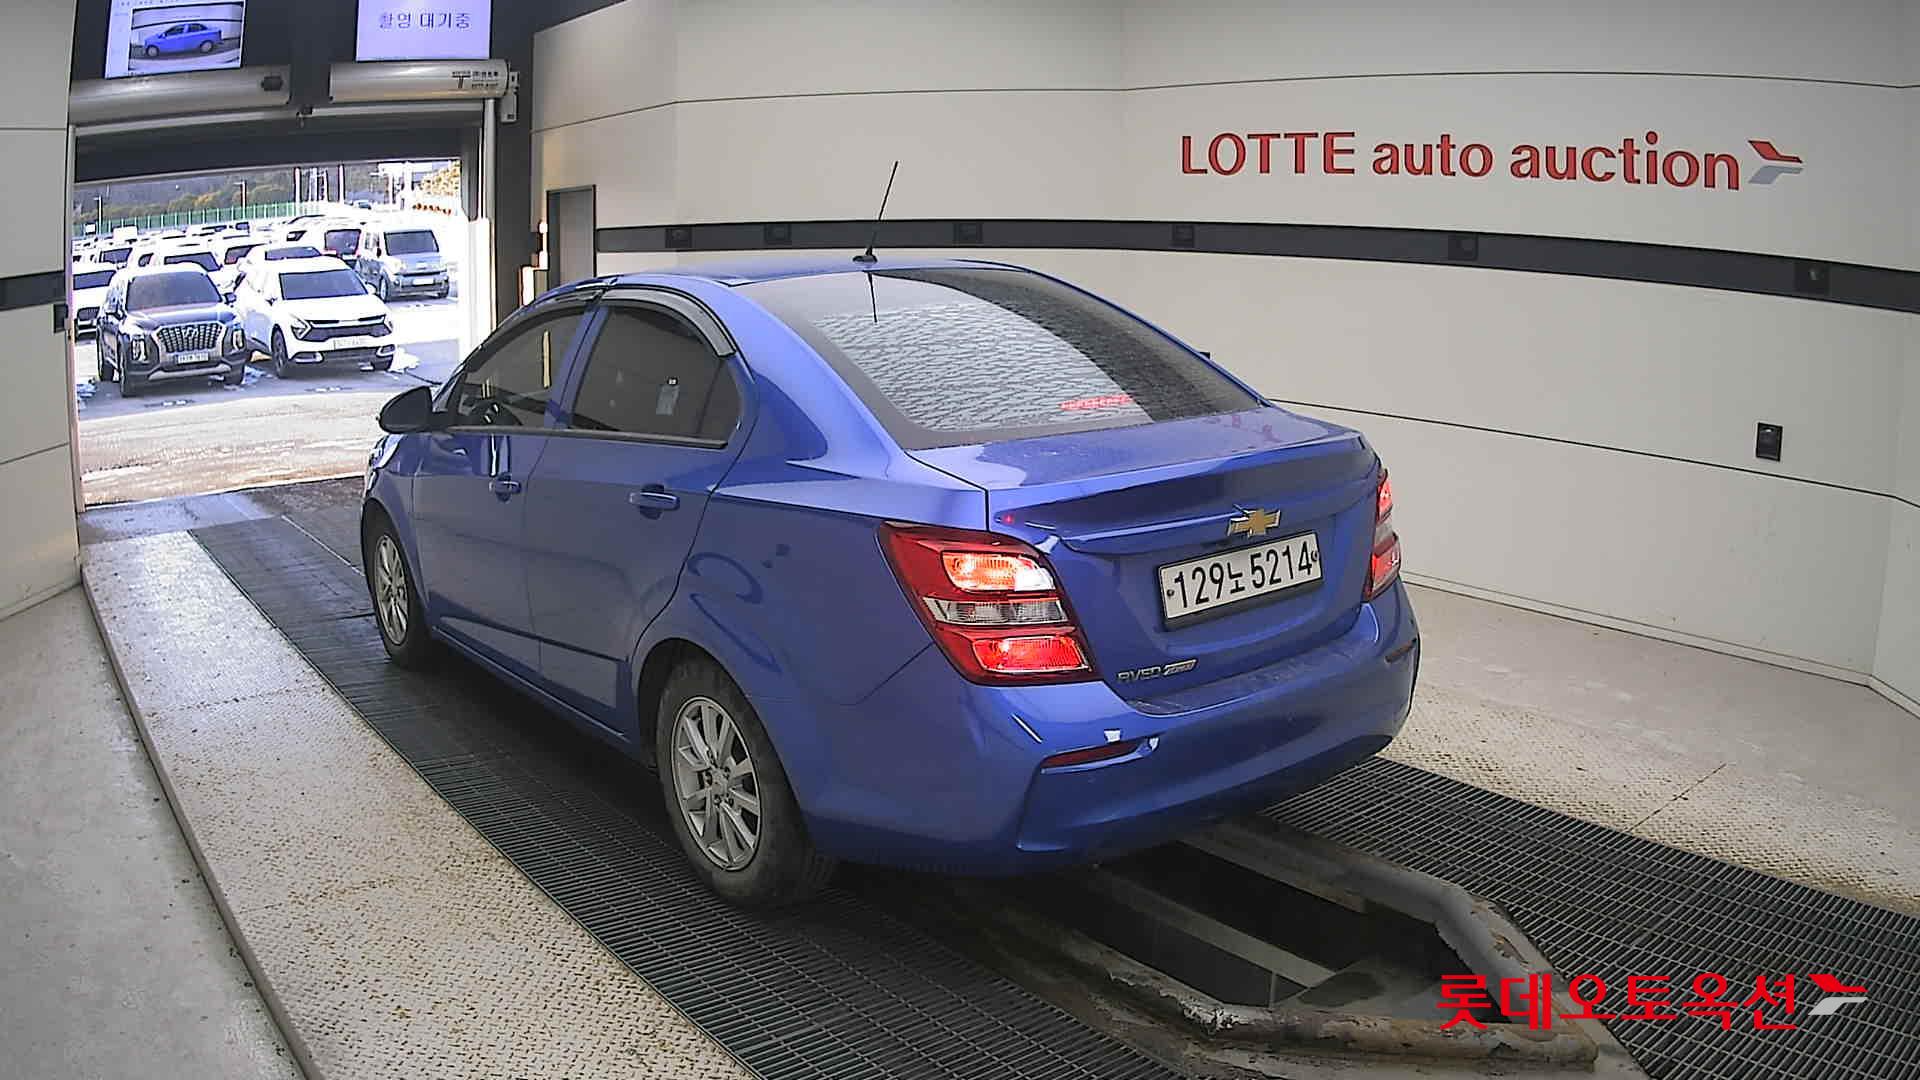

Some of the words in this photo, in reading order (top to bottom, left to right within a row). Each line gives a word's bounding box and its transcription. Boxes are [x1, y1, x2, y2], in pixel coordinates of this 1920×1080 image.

[419, 12, 470, 29] 대기중
[1182, 132, 1355, 177] LOTTE
[1372, 133, 1495, 177] auto
[1510, 132, 1741, 190] auction
